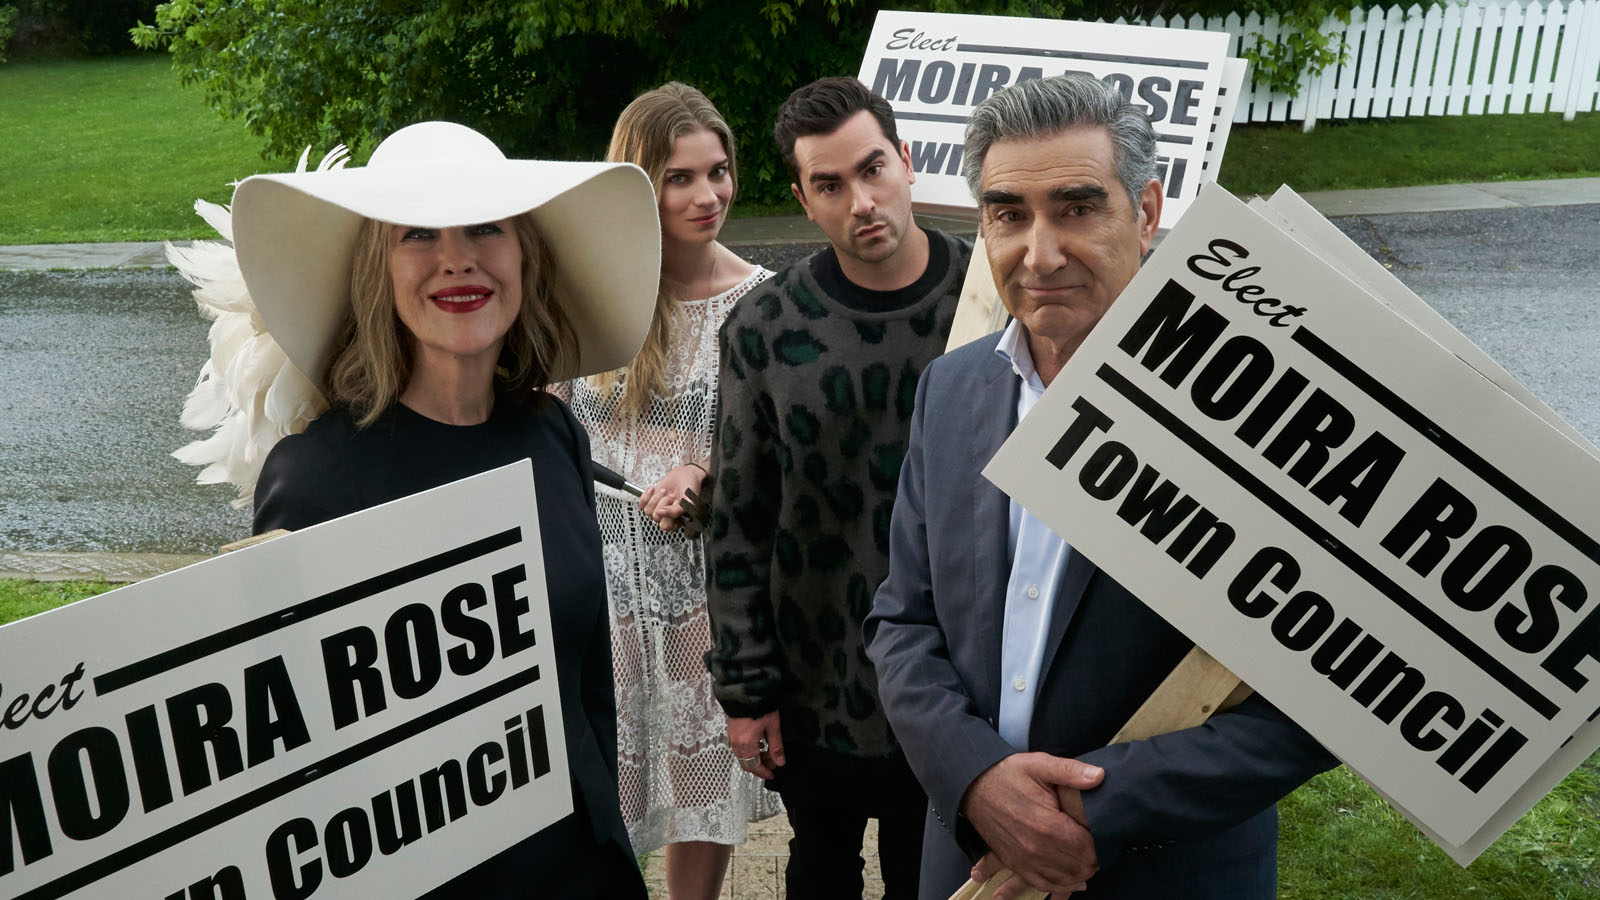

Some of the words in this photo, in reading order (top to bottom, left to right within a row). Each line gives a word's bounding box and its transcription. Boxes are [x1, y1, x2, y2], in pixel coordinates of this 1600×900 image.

[870, 58, 1043, 106] MOIR
[886, 28, 957, 51] Elect
[1186, 238, 1307, 328] Elect
[1117, 278, 1407, 529] MOIRA
[320, 563, 537, 731] ROSE
[1044, 395, 1237, 580] Town
[1227, 546, 1529, 794] Council
[265, 704, 551, 900] Council
